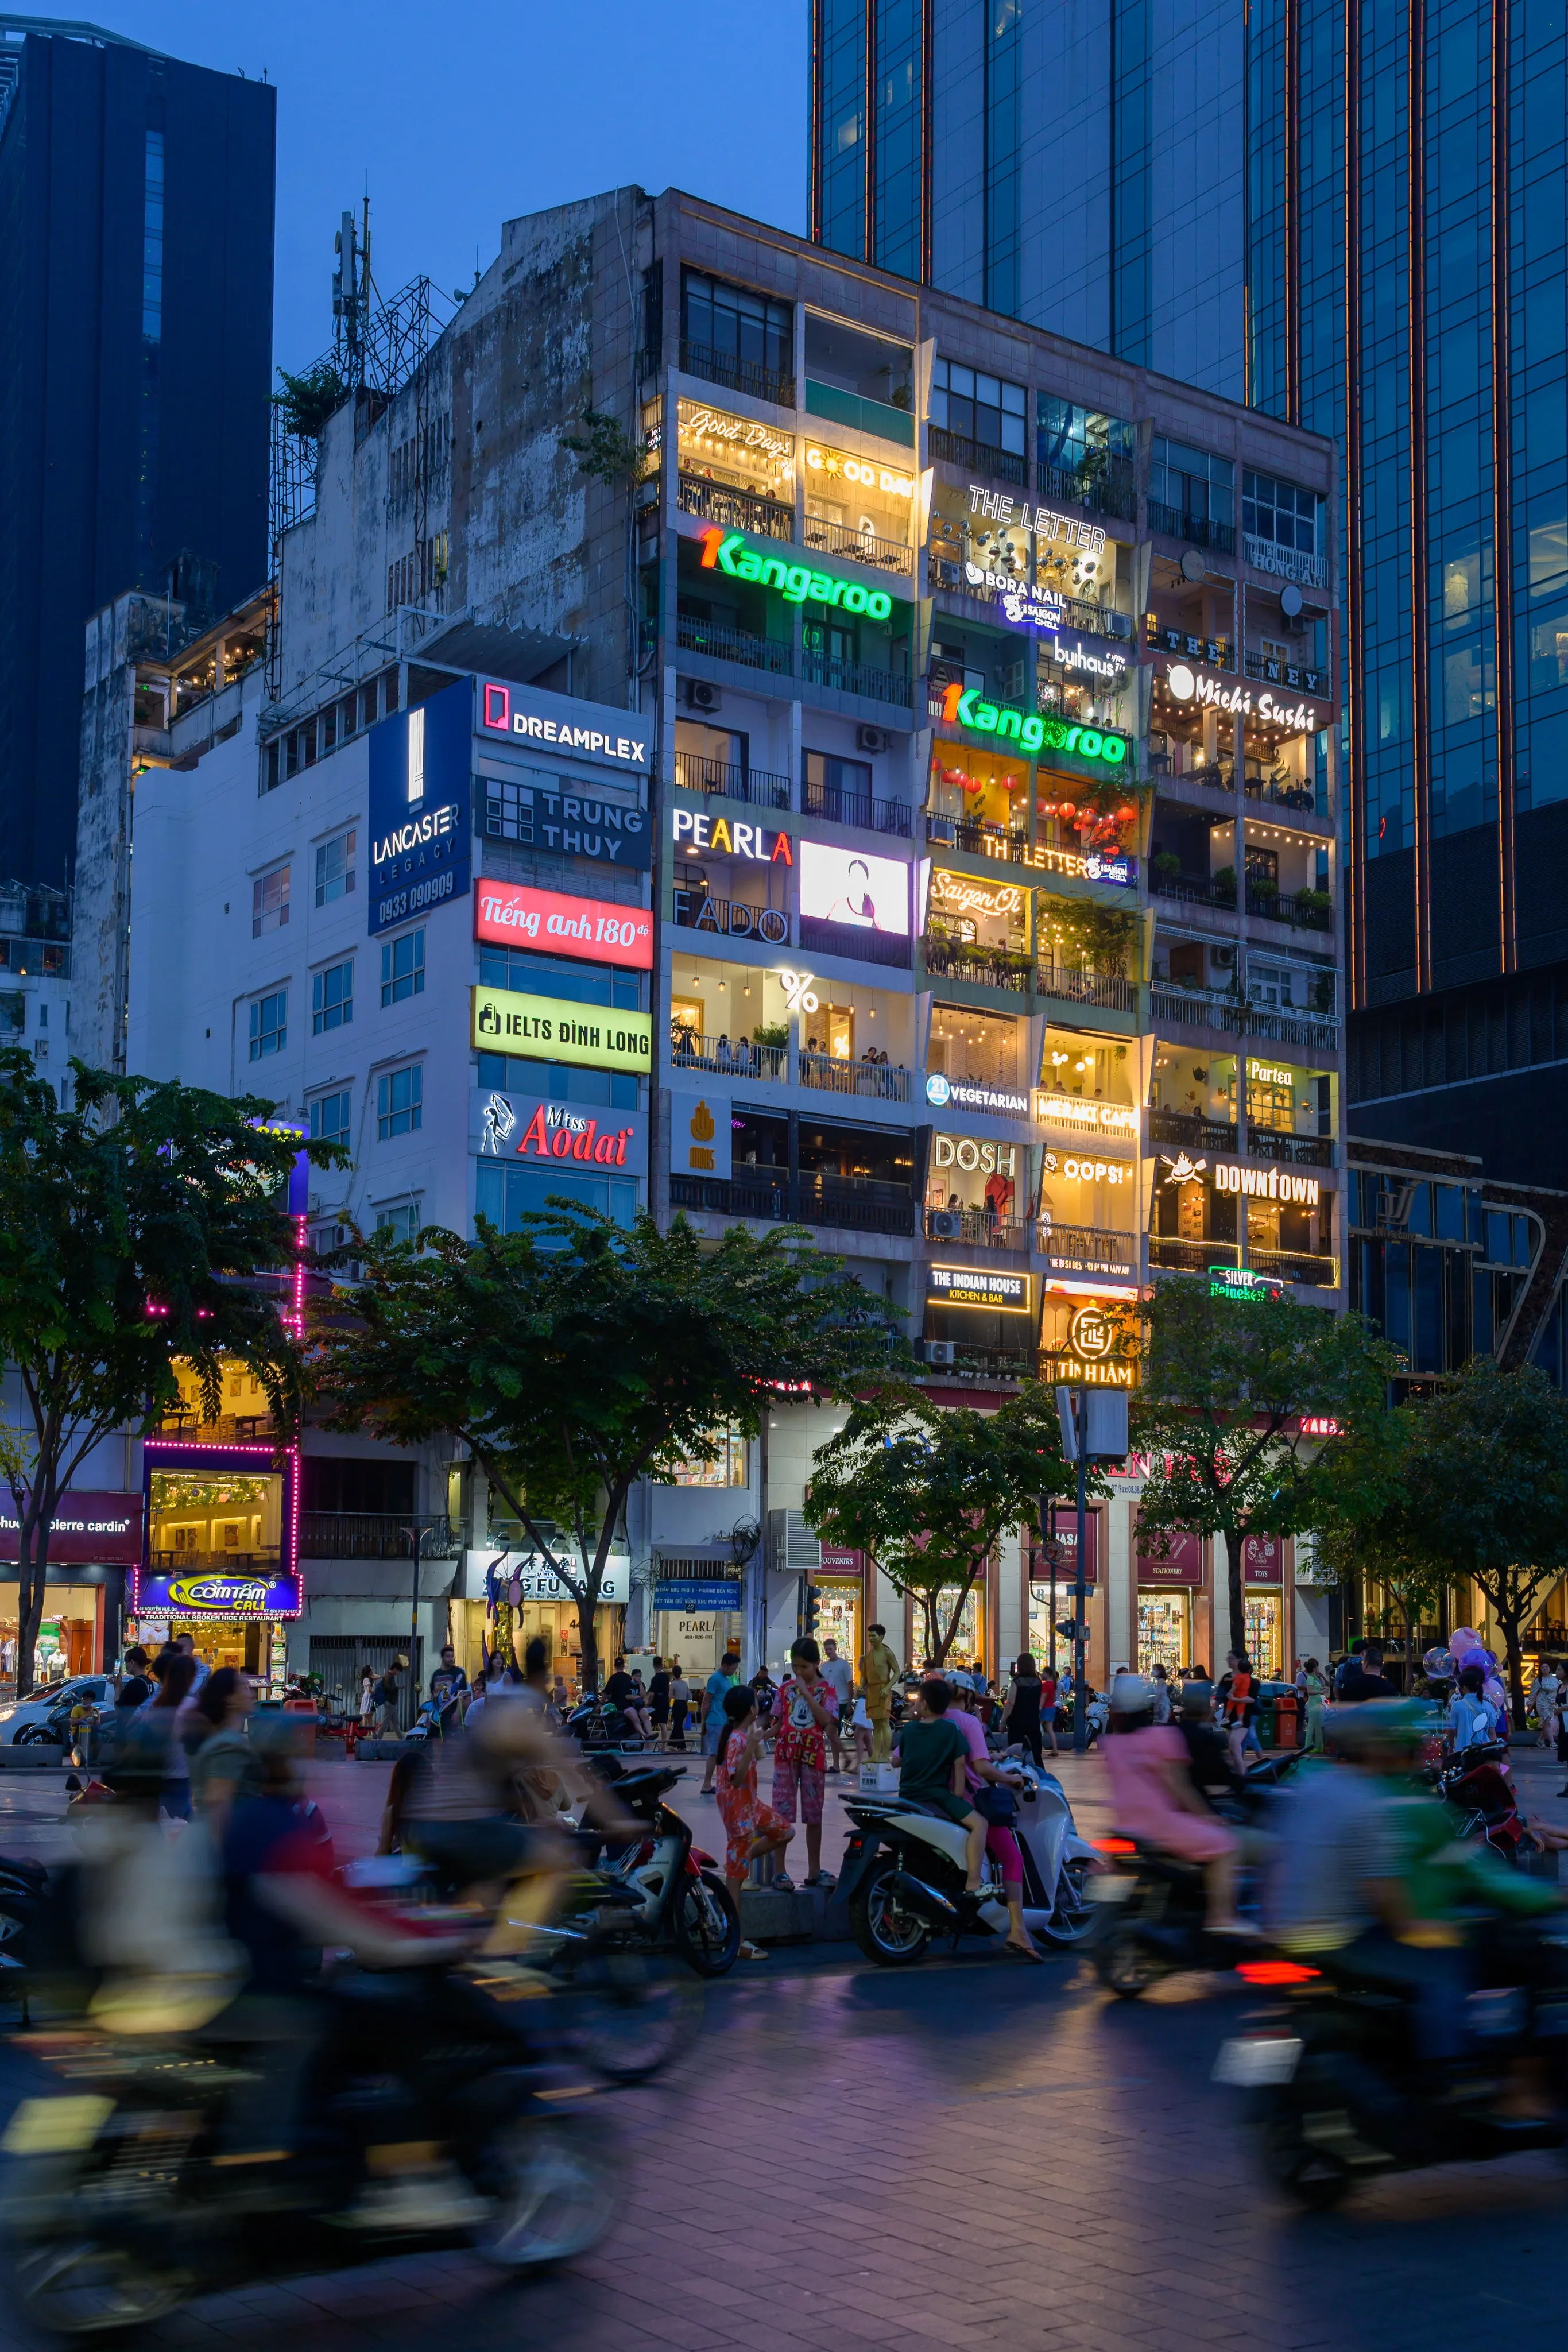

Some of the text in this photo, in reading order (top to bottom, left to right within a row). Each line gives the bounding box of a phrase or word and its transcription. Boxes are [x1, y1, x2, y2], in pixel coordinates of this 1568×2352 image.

[690, 410, 791, 458] Good Days
[969, 484, 1107, 555] THE LETTER
[985, 571, 1067, 609] BORA NAIL
[1034, 618, 1059, 631] CHILL
[1167, 630, 1318, 691] THE NEY
[1195, 675, 1315, 732] Michi Sushi
[513, 713, 645, 763] DREAMPLEX
[374, 803, 459, 865] LANCASTER
[542, 792, 643, 834] TRUNG
[541, 824, 622, 860] THUY
[672, 808, 793, 866] PEARLA
[379, 837, 454, 884] LEGACY
[1024, 844, 1089, 879] LETTER
[379, 871, 454, 924] 0933 090909
[930, 872, 1001, 916] Saigon
[480, 896, 541, 938] Tiếng
[547, 912, 593, 941] anh
[595, 917, 636, 947] 180
[673, 889, 789, 945] FADO
[506, 1013, 649, 1055] IELTS ĐÌNH LONG
[931, 1077, 945, 1093] 21
[950, 1085, 1027, 1112] VEGETARIAN
[517, 1104, 628, 1166] Aodai
[547, 1105, 586, 1131] Miss
[935, 1135, 1015, 1177] DOSH
[1064, 1159, 1124, 1185] OOPS!
[932, 1271, 1020, 1294] THE INDIAN HOUSE
[950, 1288, 1004, 1304] KITCHEN & BAR
[1225, 1270, 1253, 1287] SILVER
[87, 1520, 126, 1533] cardin
[233, 1600, 265, 1611] CALI
[535, 1578, 560, 1596] FU
[567, 1580, 615, 1599] AG
[776, 1730, 820, 1750] MCKEY
